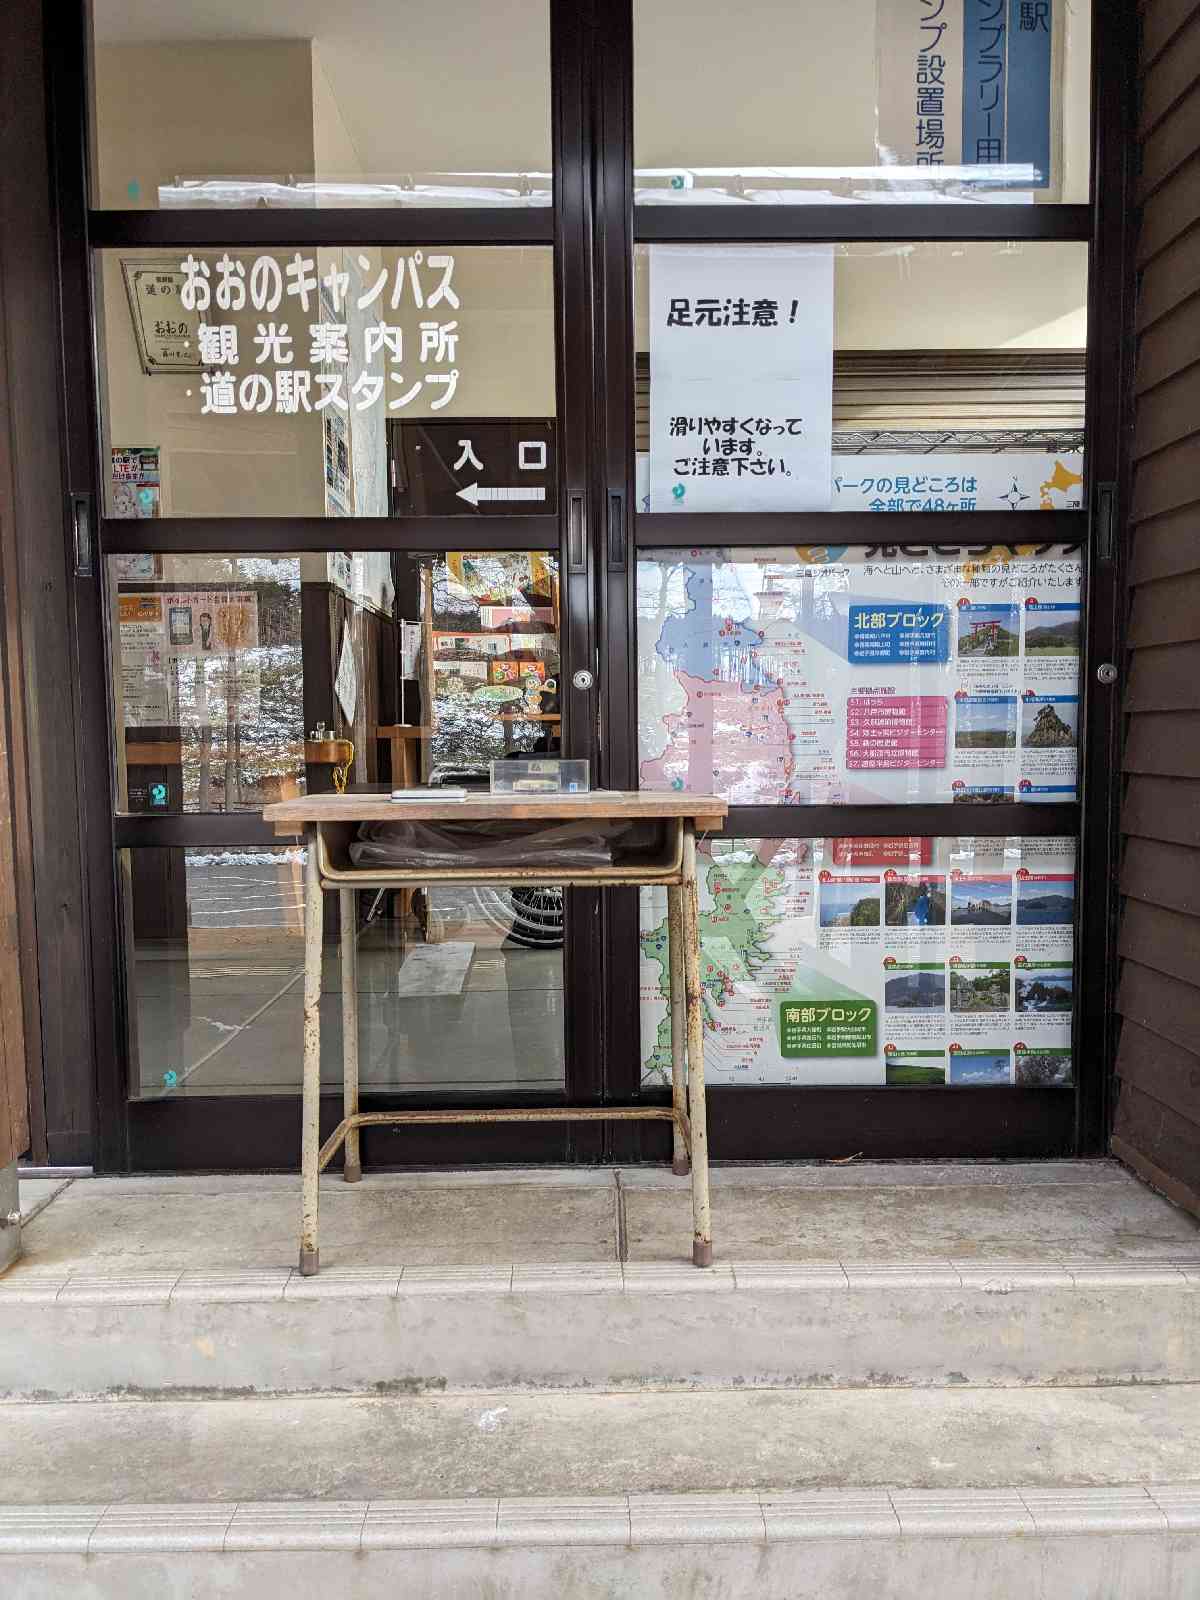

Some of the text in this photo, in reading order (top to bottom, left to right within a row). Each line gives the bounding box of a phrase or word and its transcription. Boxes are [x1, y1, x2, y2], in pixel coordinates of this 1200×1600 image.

[1019, 2, 1049, 33] 駅
[180, 251, 460, 312] おおのキャンパス
[666, 298, 800, 328] 足元注意！
[669, 416, 803, 438] 滑りやすくなって
[702, 437, 764, 457] います。
[673, 457, 794, 478] ご注意下さい。
[853, 611, 945, 630] 北部ブロック
[785, 1007, 872, 1023] 南部ブロック
